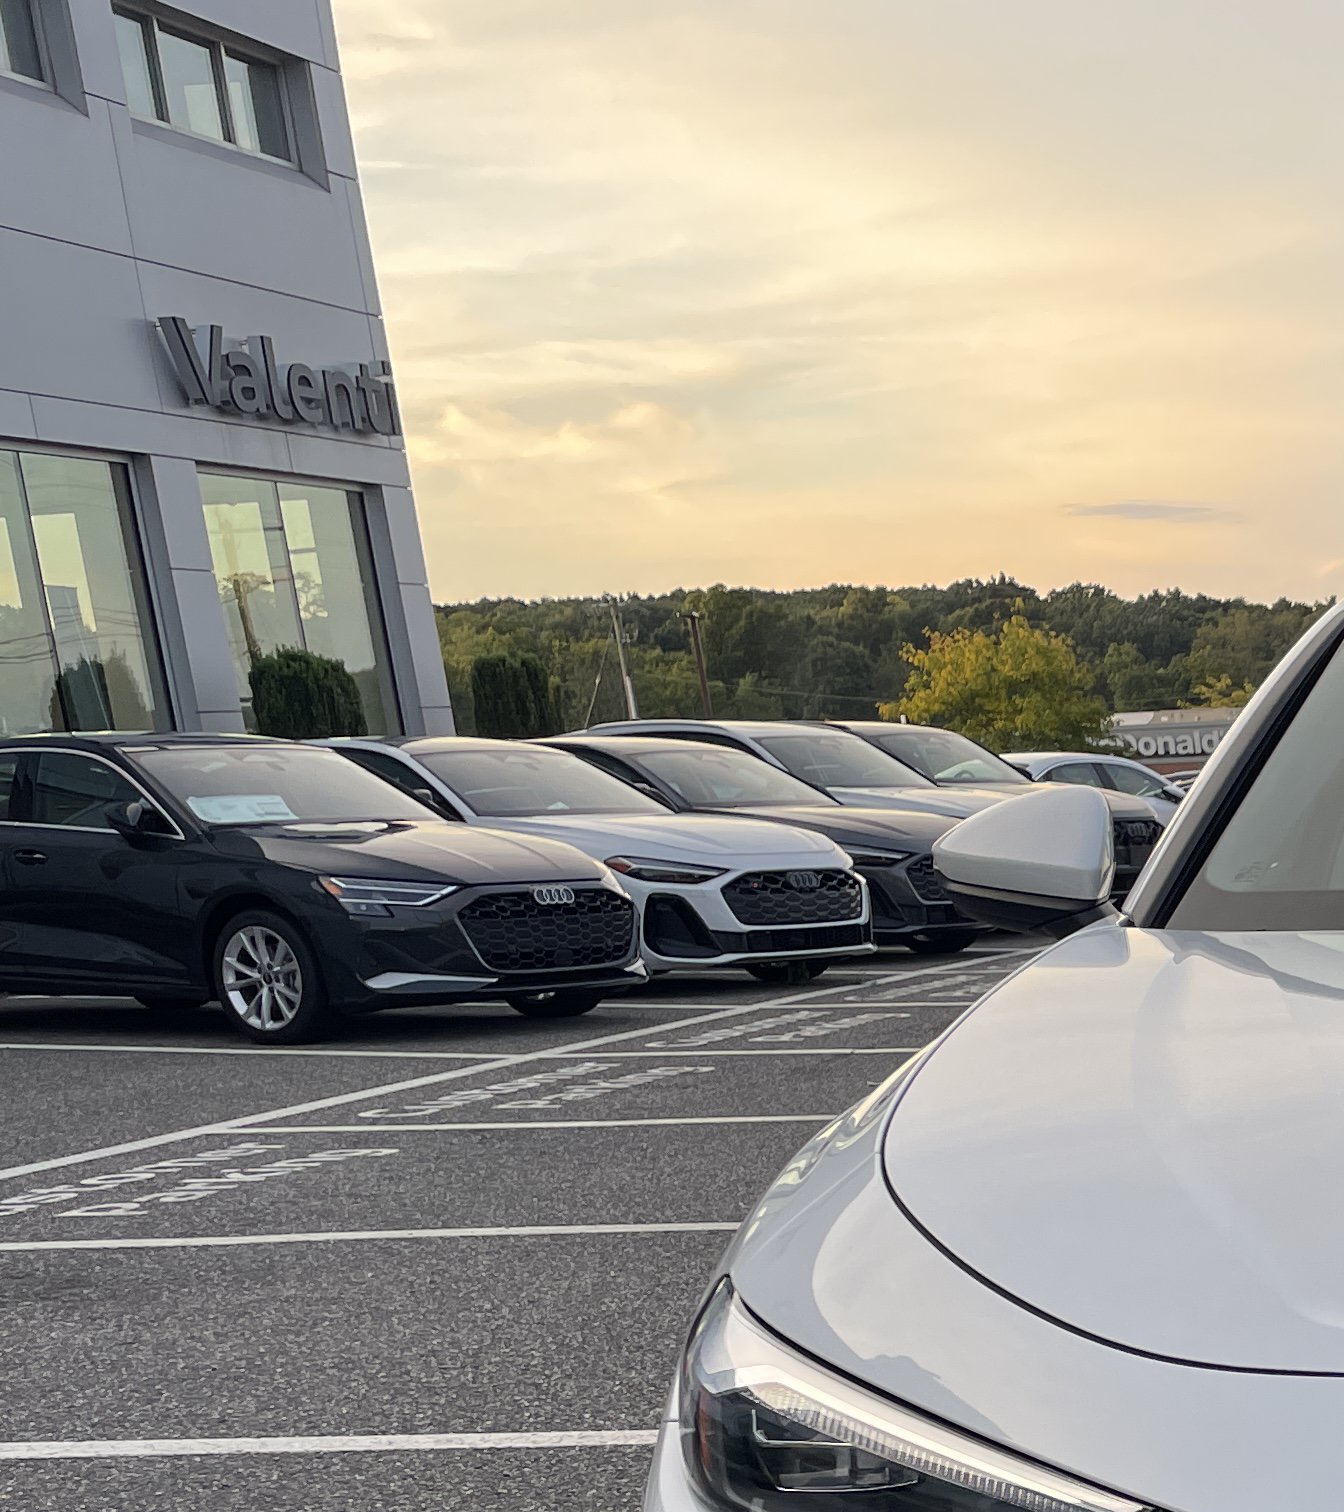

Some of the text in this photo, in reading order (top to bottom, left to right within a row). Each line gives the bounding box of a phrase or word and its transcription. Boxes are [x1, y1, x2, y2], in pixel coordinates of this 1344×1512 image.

[157, 316, 401, 436] Valenti
[357, 1062, 621, 1117] Customer
[491, 1066, 715, 1108] Parking
[0, 1142, 286, 1217] ustomer
[53, 1148, 400, 1217] Parking
